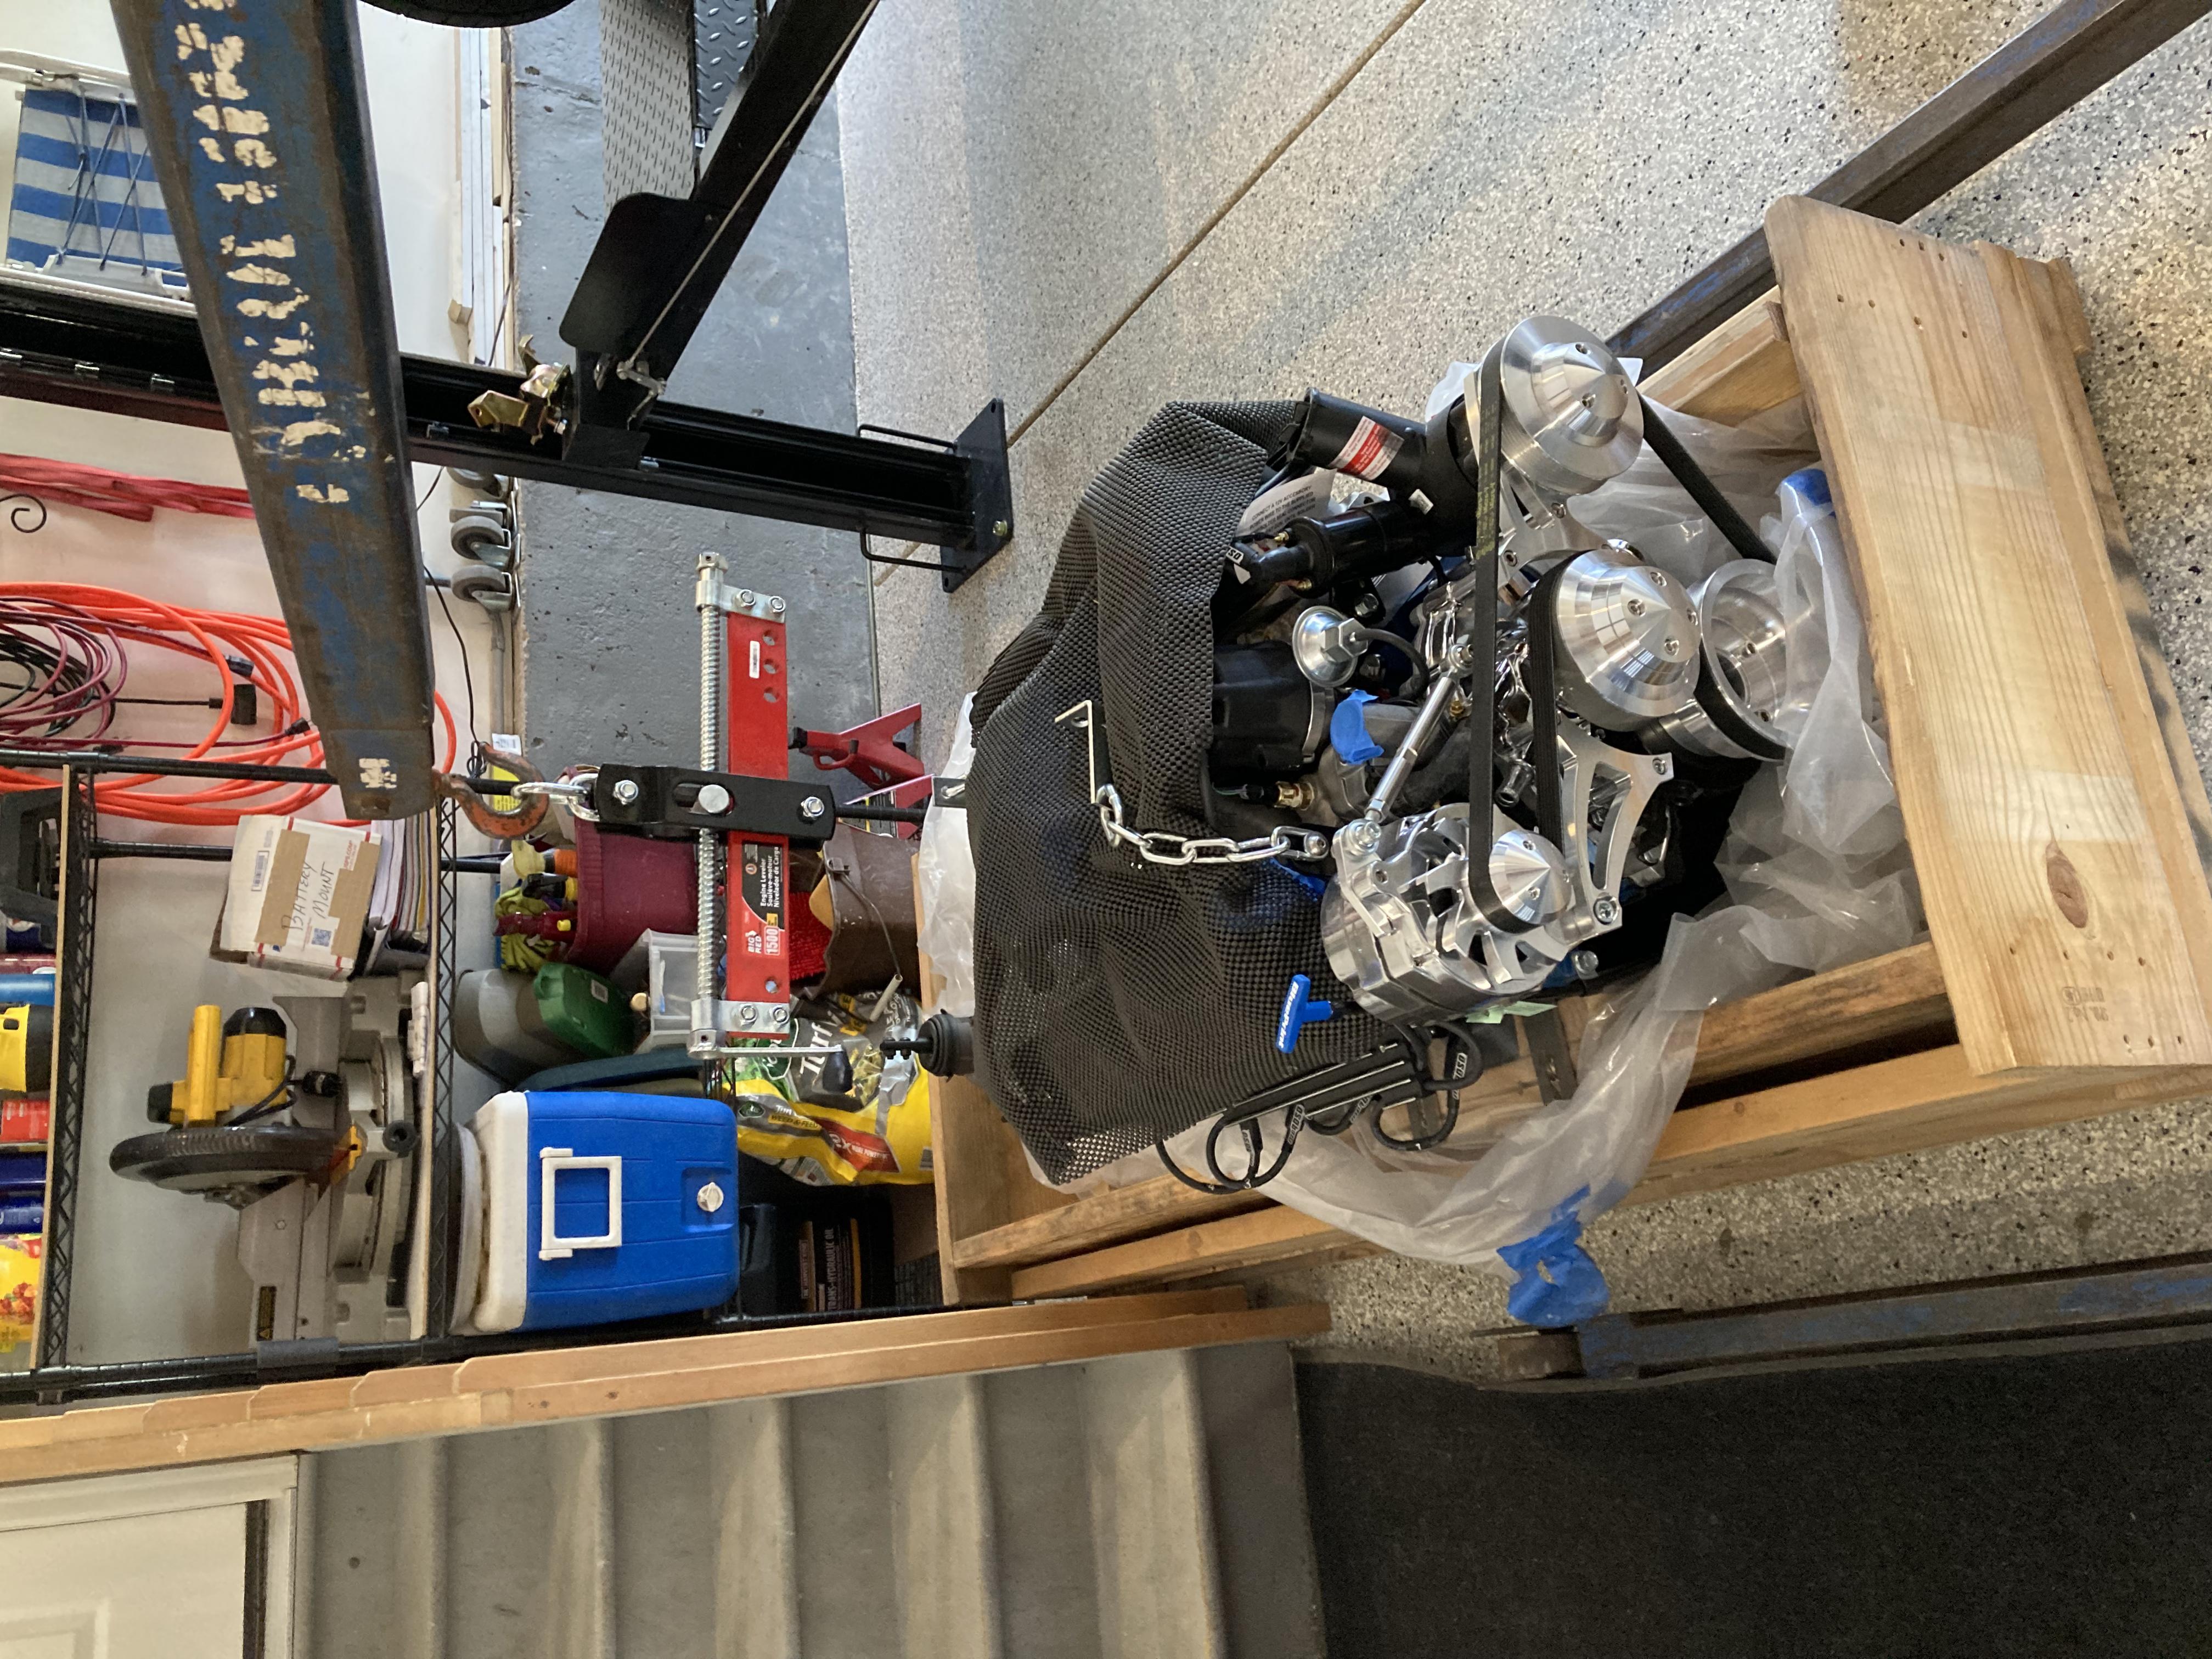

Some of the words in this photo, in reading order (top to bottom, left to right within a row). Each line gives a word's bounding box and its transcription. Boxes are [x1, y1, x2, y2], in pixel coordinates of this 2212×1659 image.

[281, 862, 317, 930] BATTERY
[312, 861, 334, 919] MOUNT
[774, 867, 779, 875] de
[766, 928, 778, 953] 1500
[1279, 981, 1299, 1048] BluePrint
[824, 1228, 834, 1239] OIL
[825, 1241, 837, 1309] TRANS-HYDRAULIC
